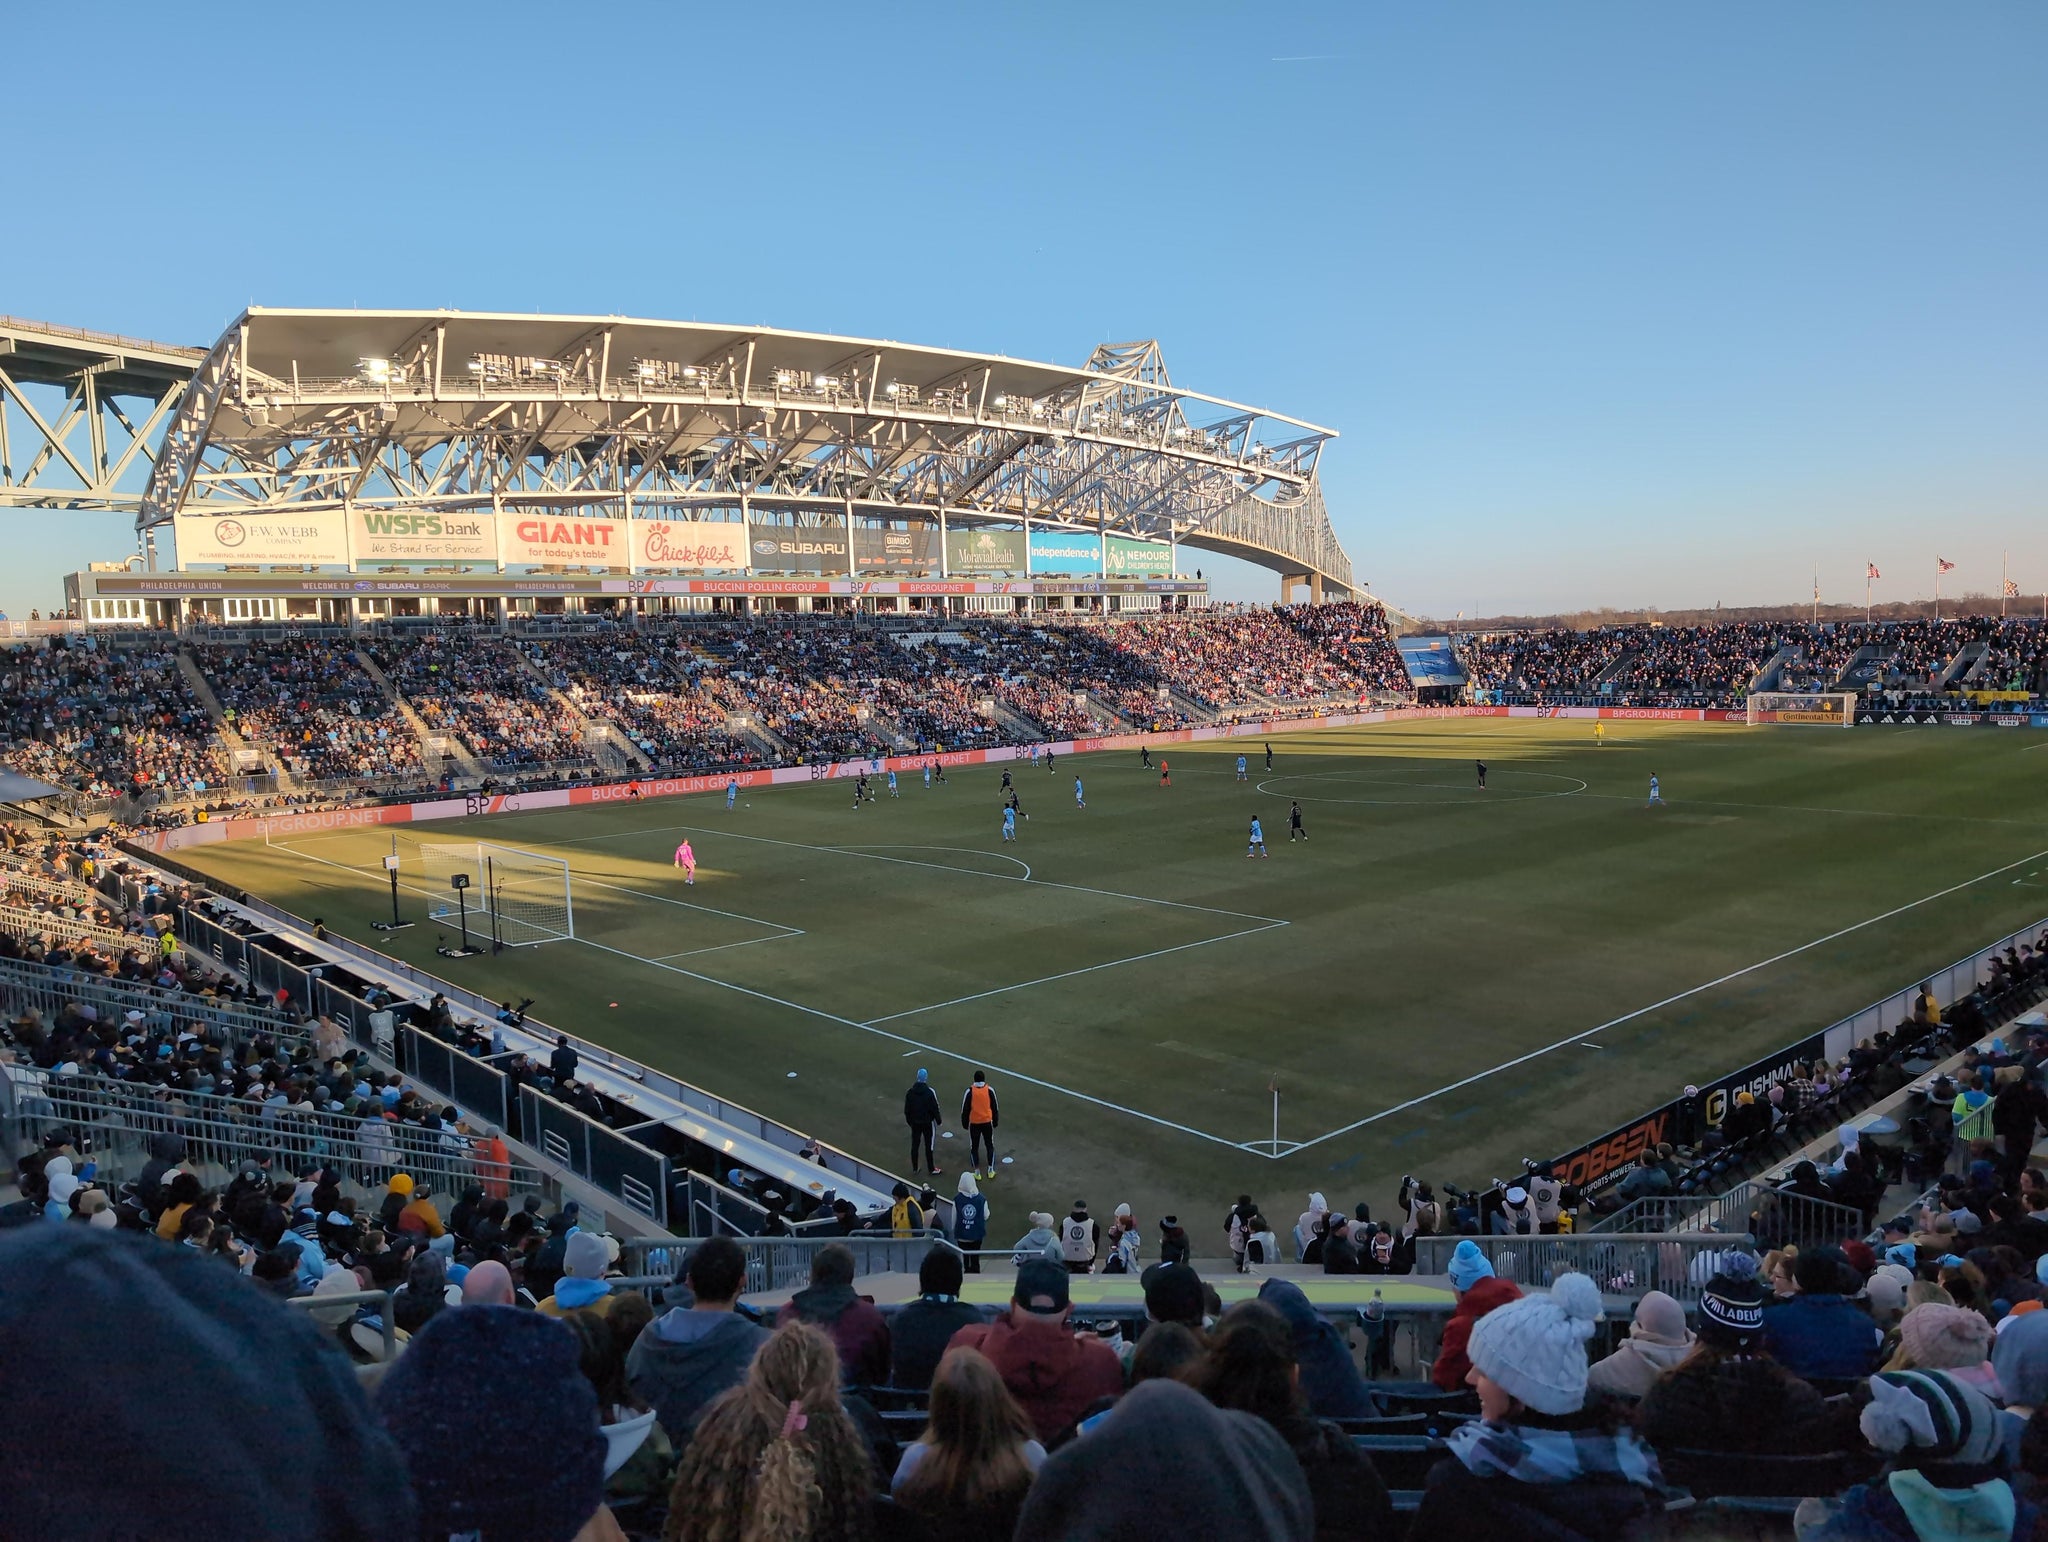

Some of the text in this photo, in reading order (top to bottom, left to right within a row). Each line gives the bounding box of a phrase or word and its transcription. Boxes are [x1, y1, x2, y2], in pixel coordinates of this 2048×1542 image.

[363, 513, 481, 536] WSFS bank
[250, 526, 318, 538] F.W. WEBB
[516, 521, 614, 546] GIANT
[265, 538, 303, 546] COMPANY
[886, 536, 910, 545] BIMBO
[371, 542, 481, 554] We Stand For Service
[528, 547, 607, 560] for today's table
[645, 531, 735, 566] Chick-fil-A
[780, 542, 845, 555] SUBARU
[1031, 546, 1090, 562] Independence
[958, 548, 1015, 563] MoraviaHealth
[1127, 550, 1170, 561] NEMOURS
[140, 582, 222, 590] PHILADELPHIA UNION
[302, 582, 338, 590] WELCOME
[340, 582, 350, 590] TO
[514, 582, 575, 590] PHILADELPHIA UNION
[703, 583, 817, 592] BUCCINI POLLIN GROUP
[910, 584, 965, 593] BPGROUP.NET
[286, 630, 301, 638] 123
[1463, 708, 1496, 716] GROUP
[1612, 709, 1683, 719] BPGROUP.NET
[1086, 738, 1122, 750] BUCCINI
[1153, 733, 1181, 744] GROUP
[591, 784, 651, 801] BUCCNI
[655, 778, 704, 794] POLLIN
[256, 809, 385, 834] BPGROUP.NET
